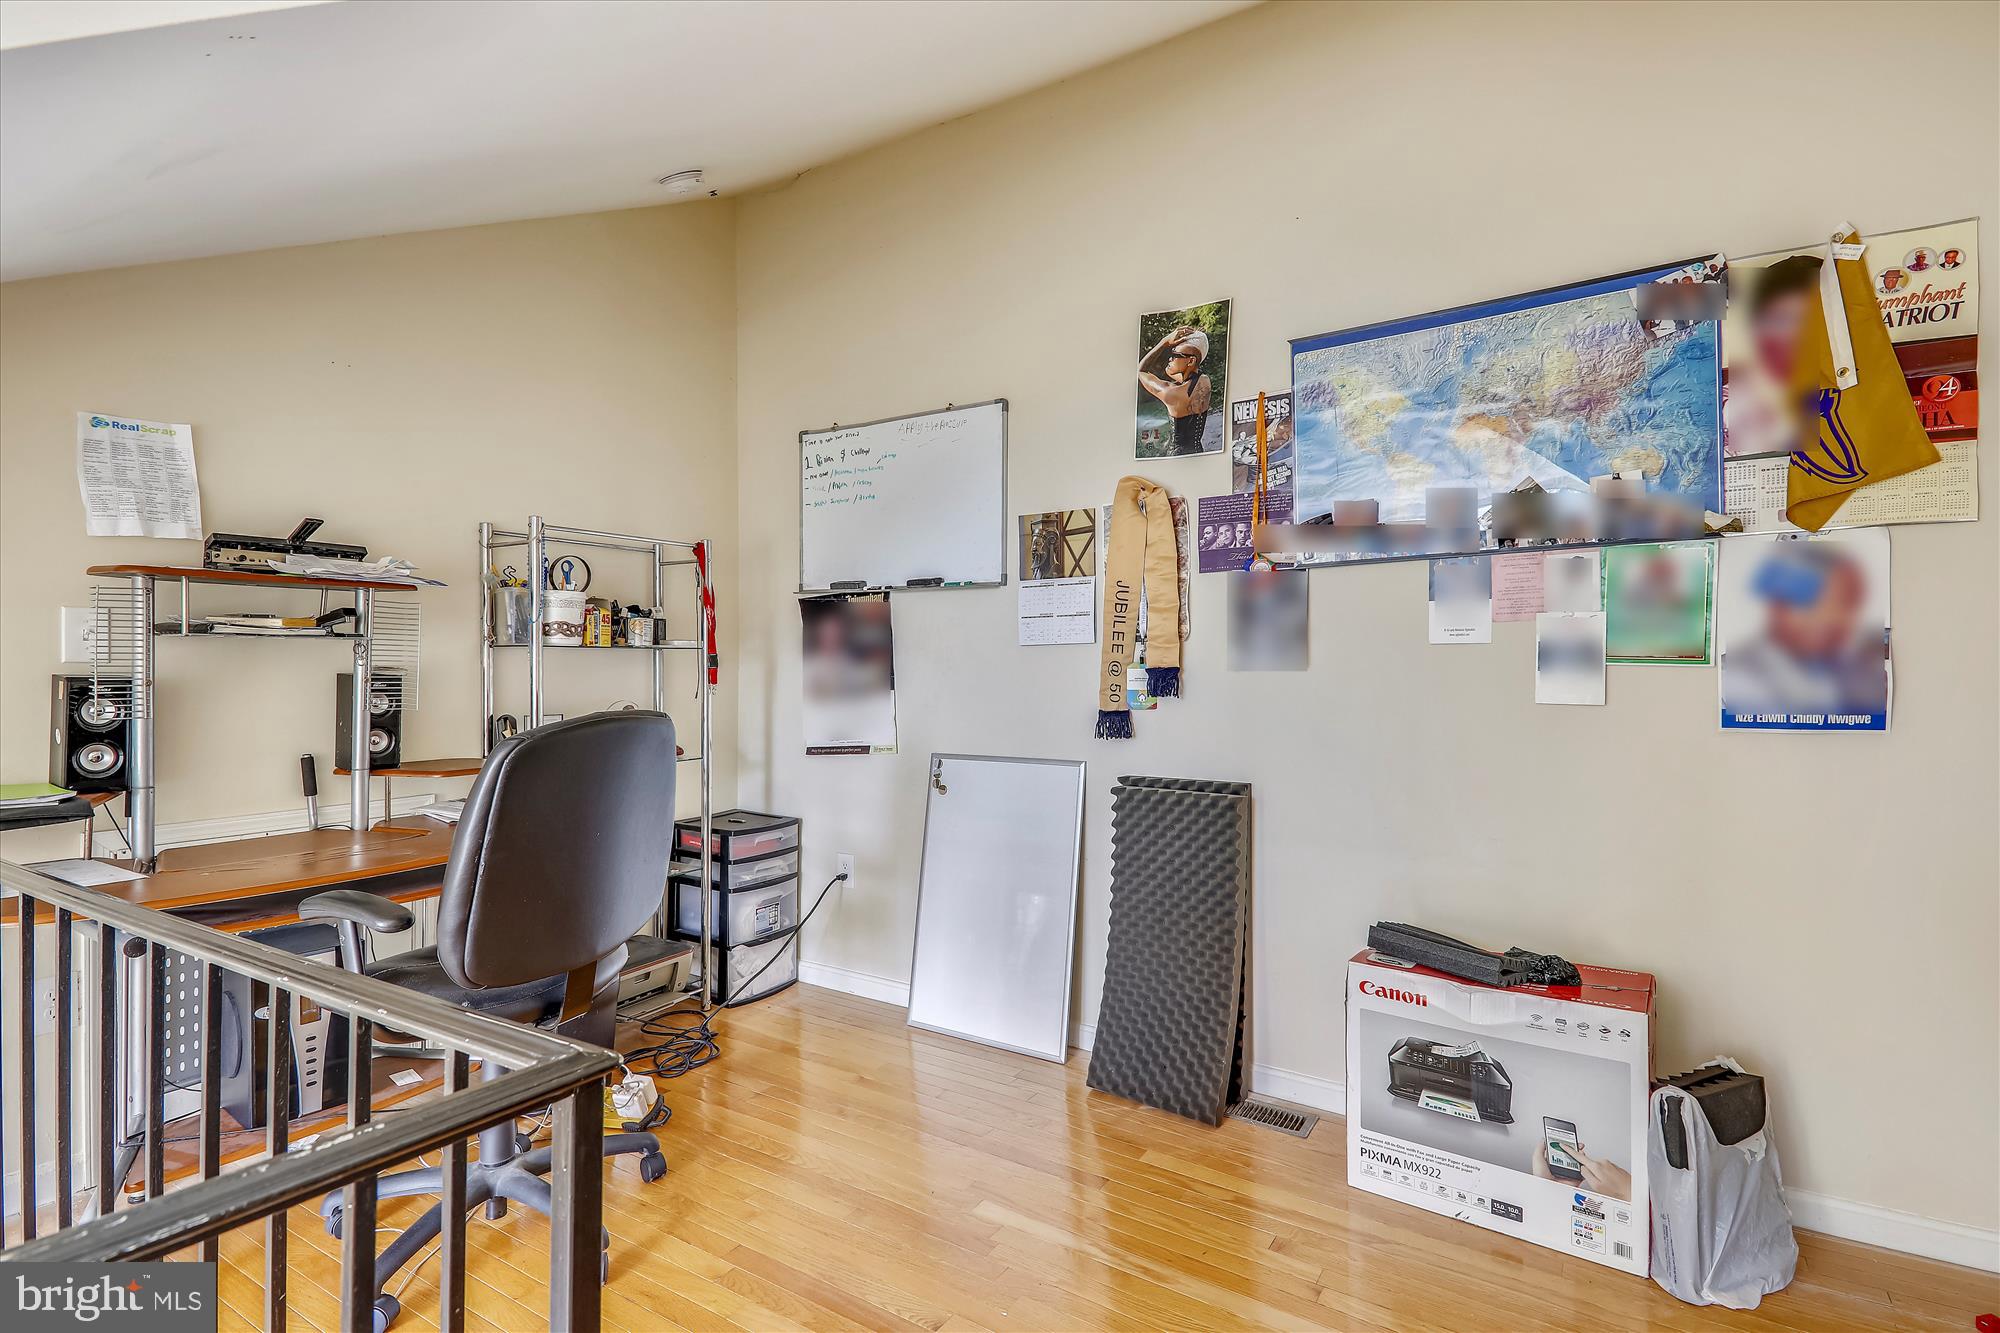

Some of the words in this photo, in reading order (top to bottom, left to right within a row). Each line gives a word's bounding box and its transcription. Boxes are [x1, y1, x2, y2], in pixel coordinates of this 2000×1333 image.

[1882, 300, 1965, 328] ATRIOT
[601, 613, 610, 624] 45
[1111, 580, 1130, 655] JUBILEE
[1108, 660, 1123, 677] @
[1110, 683, 1122, 703] 50
[1359, 980, 1427, 1007] Canon
[1360, 1146, 1402, 1168] PIXMA
[1404, 1159, 1442, 1180] MX922
